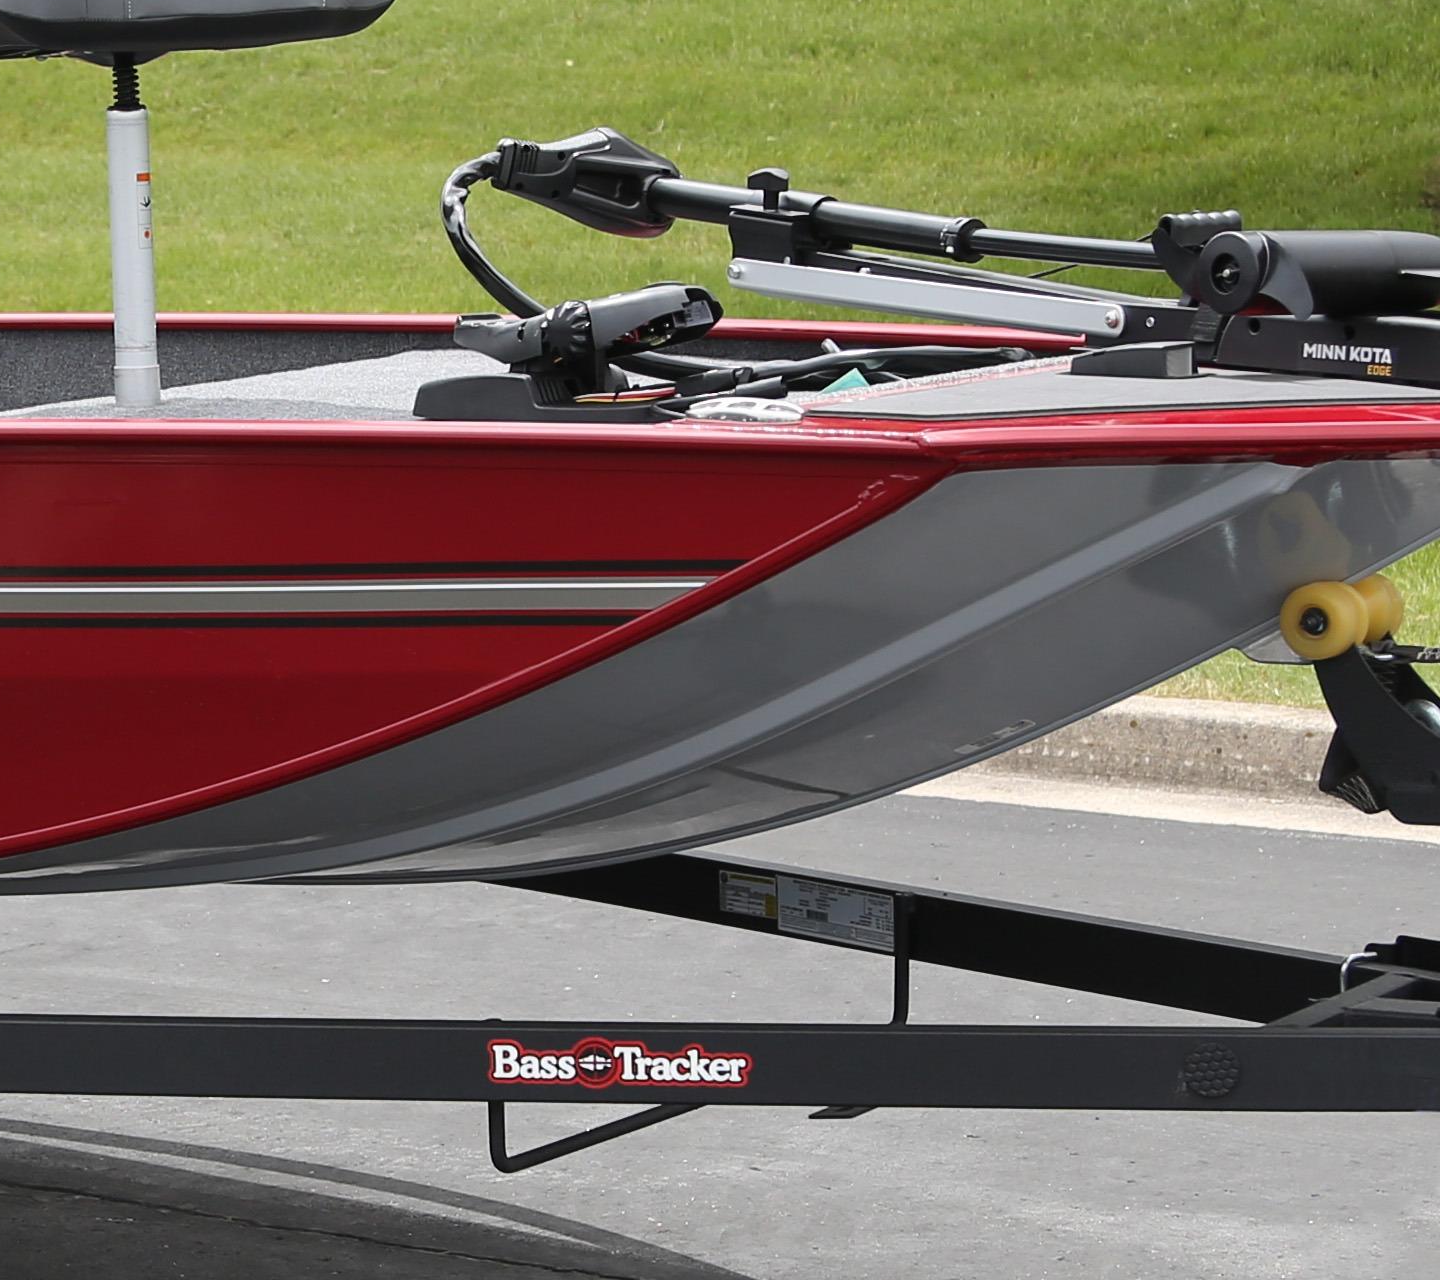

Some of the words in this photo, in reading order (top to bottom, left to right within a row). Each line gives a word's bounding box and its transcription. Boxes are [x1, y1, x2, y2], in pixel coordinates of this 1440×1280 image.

[1302, 342, 1347, 361] MINN
[1348, 345, 1392, 364] KOTA
[1366, 364, 1393, 376] EDGE
[491, 1044, 576, 1079] Bass
[613, 1045, 746, 1083] Tracker
